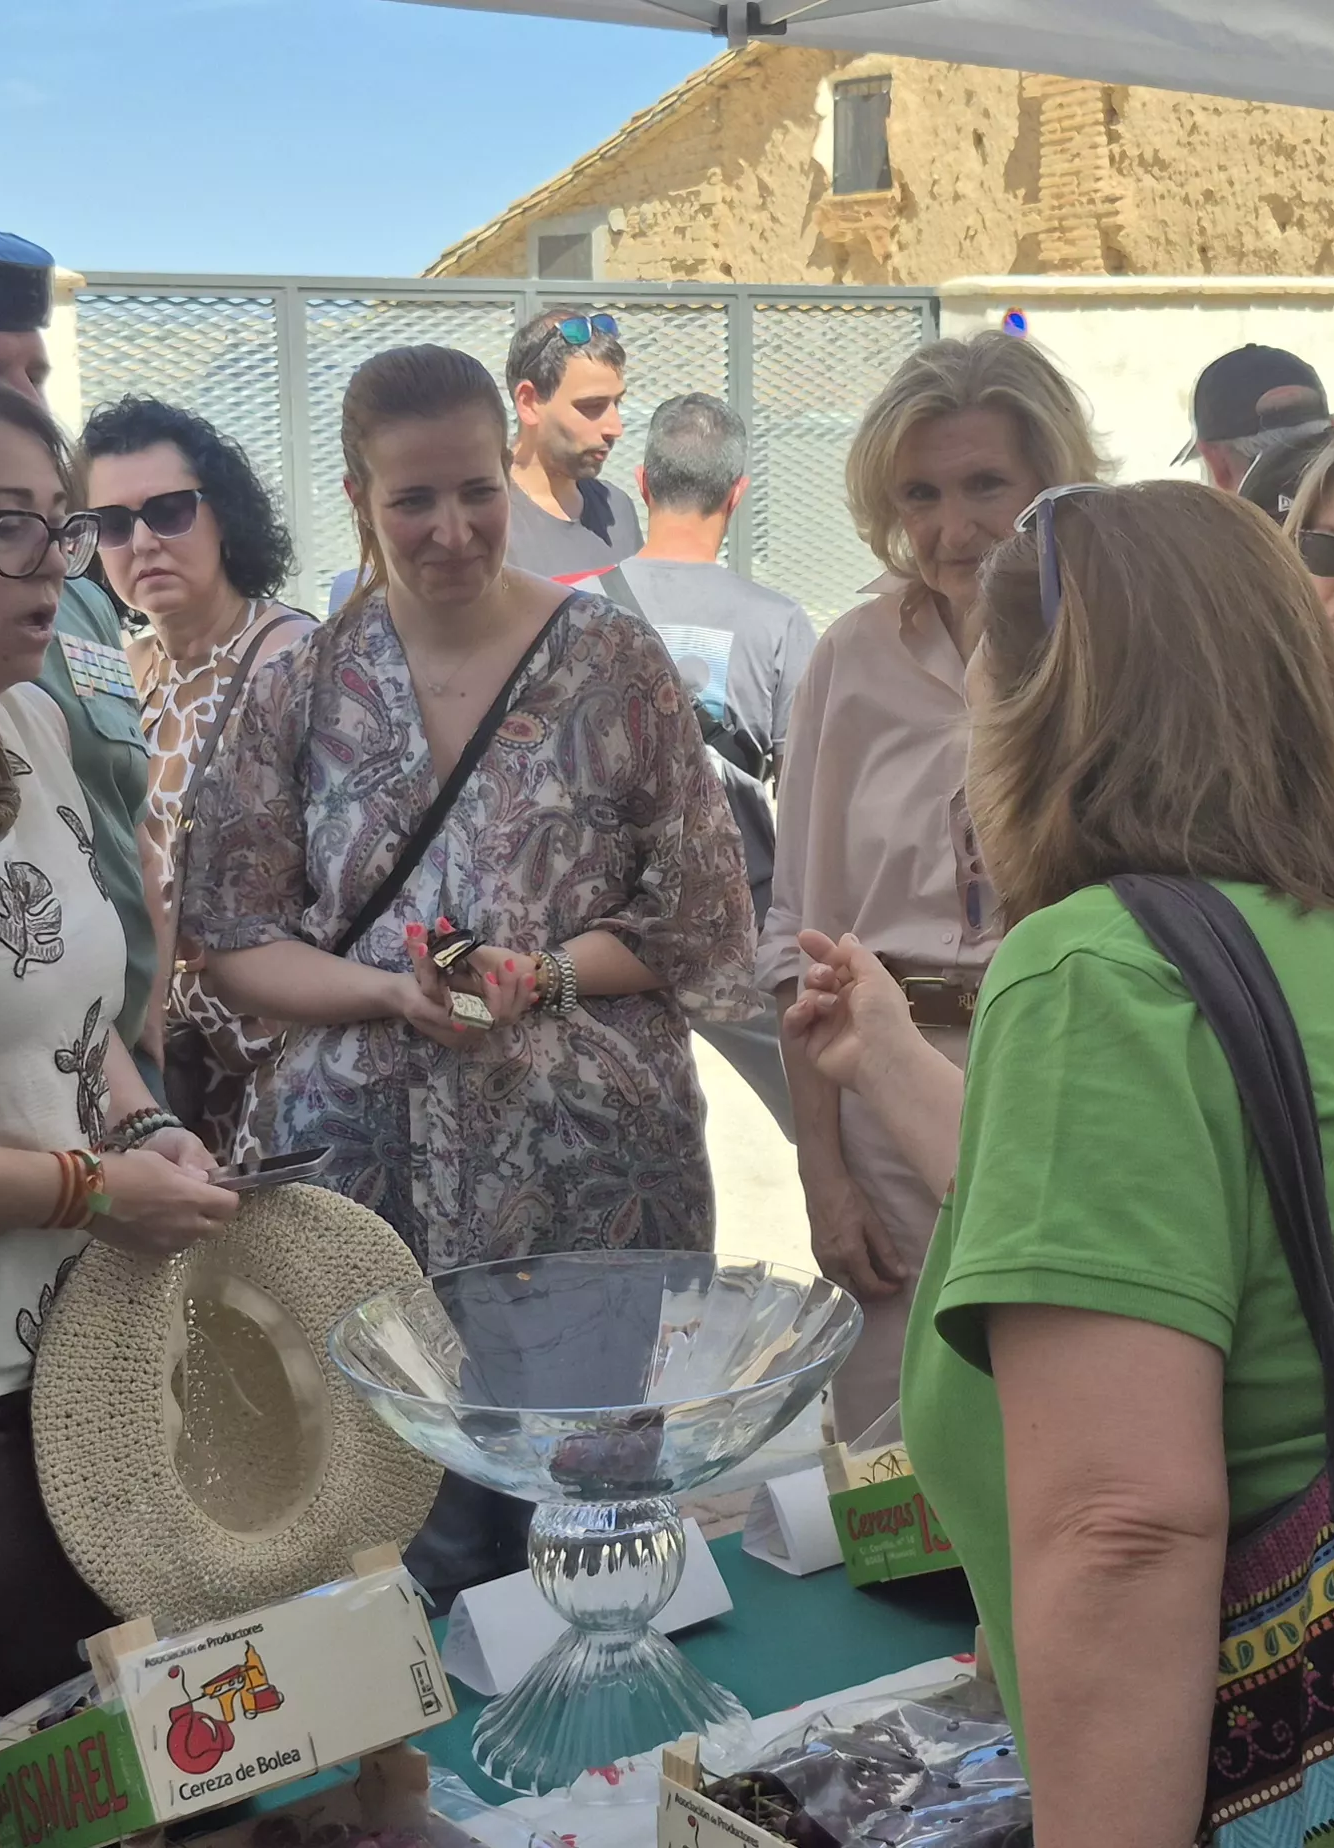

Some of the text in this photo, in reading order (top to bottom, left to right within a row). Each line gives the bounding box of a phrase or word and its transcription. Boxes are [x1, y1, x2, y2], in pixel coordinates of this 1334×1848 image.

[847, 1502, 915, 1542] Cerezas
[197, 1643, 207, 1652] de
[206, 1623, 265, 1649] Productores
[6, 1731, 129, 1848] ISMAEL
[178, 1748, 302, 1801] Cereza de Bolea
[717, 1815, 760, 1848] Productores
